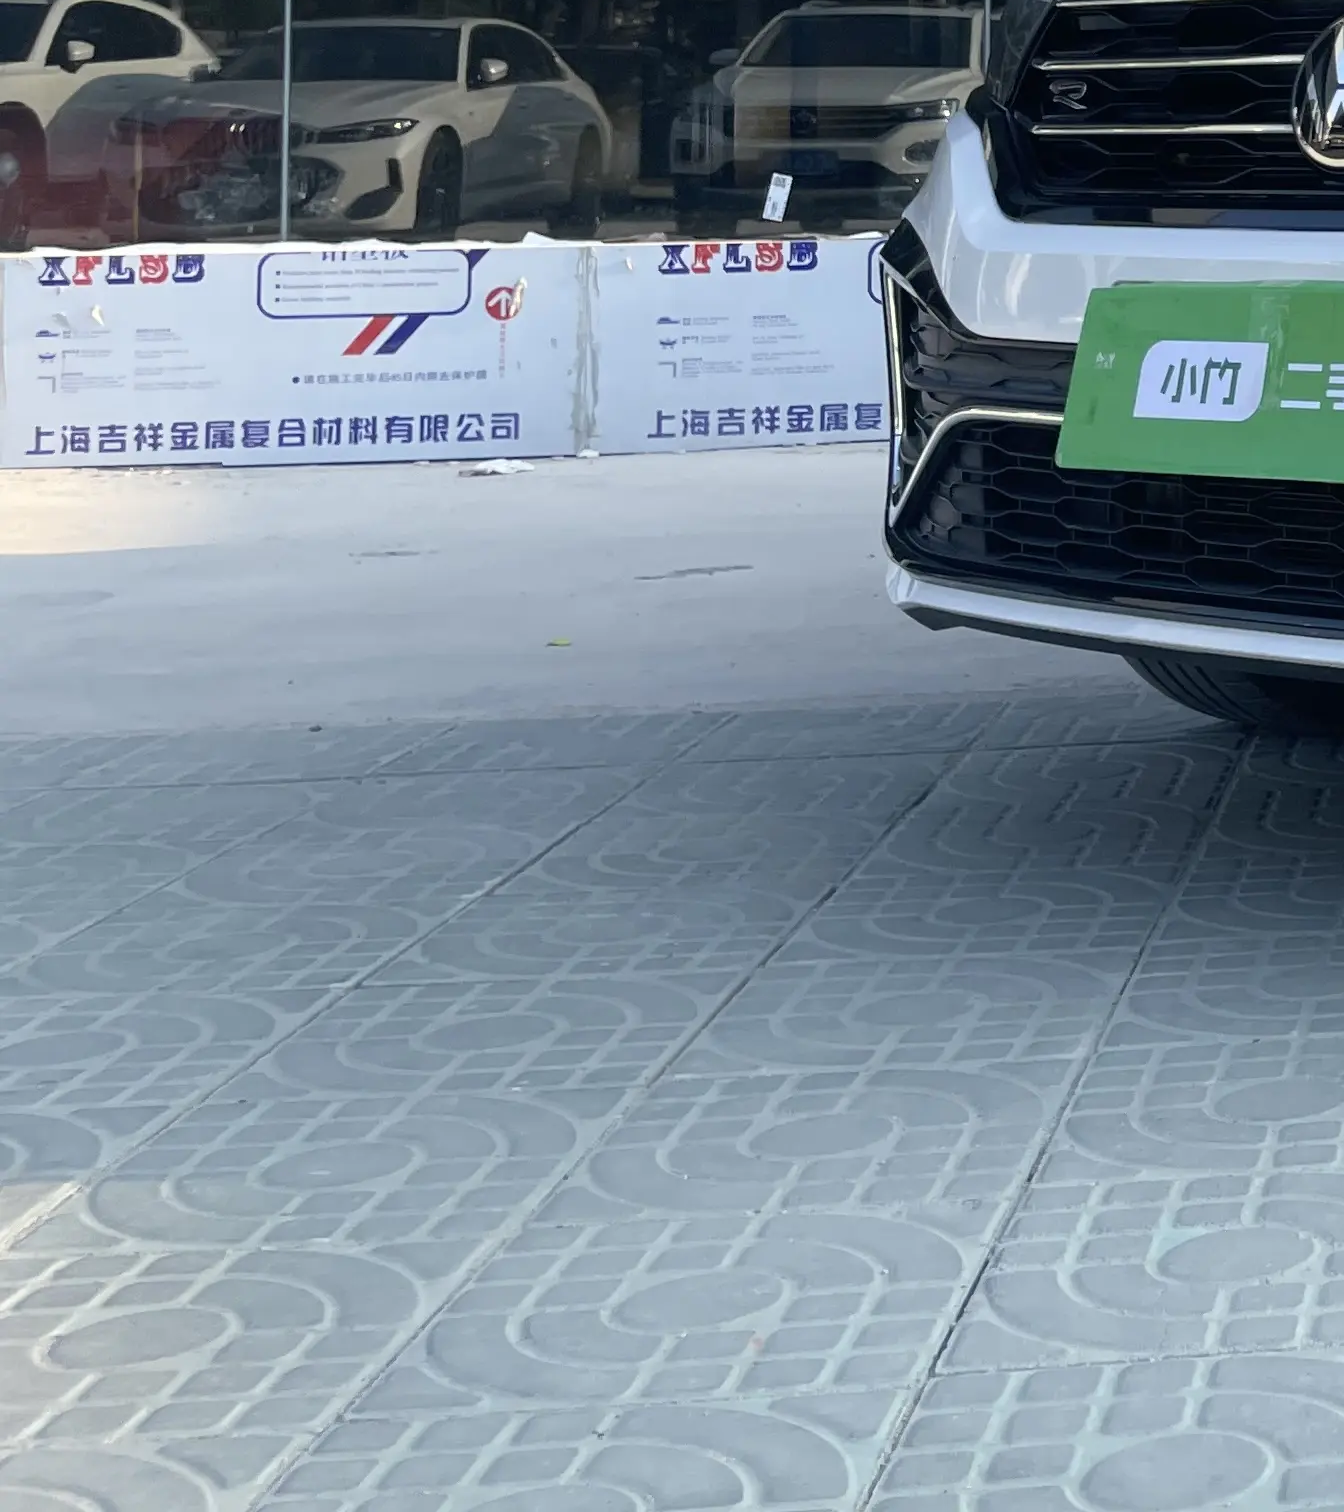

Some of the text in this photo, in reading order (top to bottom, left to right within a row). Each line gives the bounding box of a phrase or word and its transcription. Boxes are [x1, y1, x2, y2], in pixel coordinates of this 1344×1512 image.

[1160, 357, 1242, 405] 小竹
[25, 412, 521, 455] 上海吉祥金属复合材料有限公司
[648, 403, 883, 438] 上海吉祥金属复
